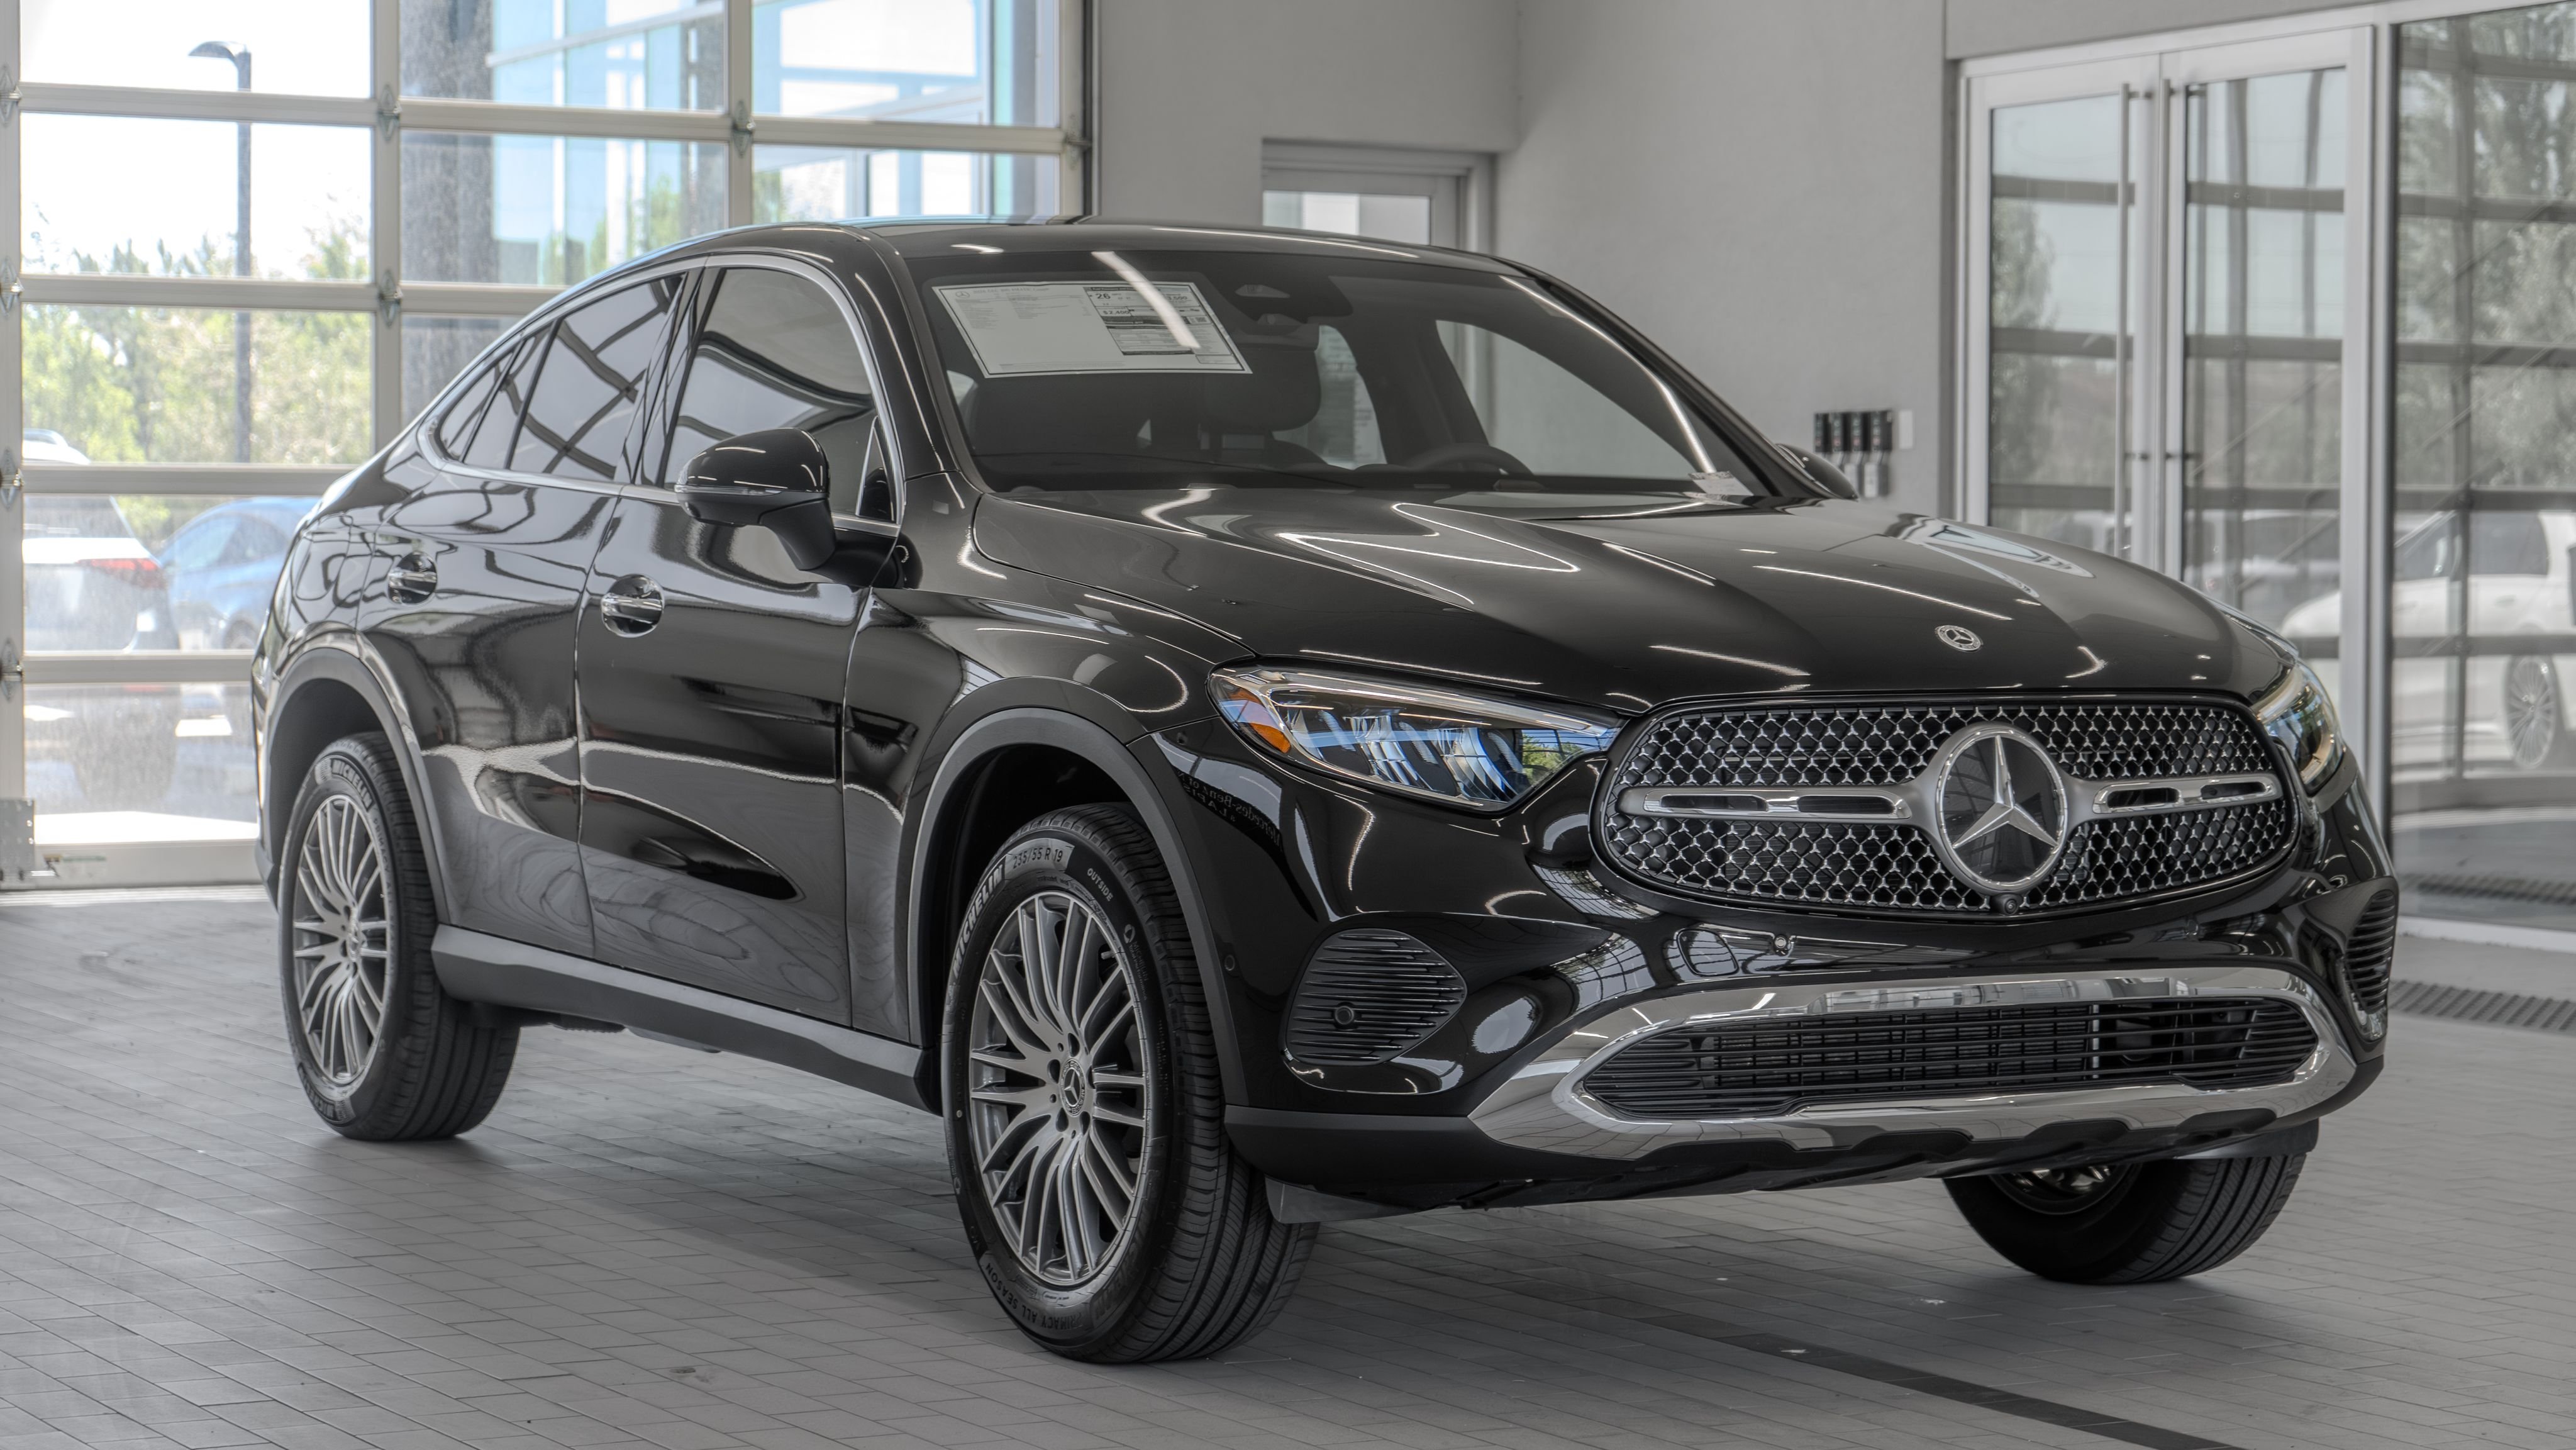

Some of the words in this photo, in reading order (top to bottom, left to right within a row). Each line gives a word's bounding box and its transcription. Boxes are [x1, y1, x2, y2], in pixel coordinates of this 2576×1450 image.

[332, 759, 372, 809] MICHELIN
[1013, 847, 1043, 869] 235/55
[1044, 847, 1052, 861] R
[1053, 848, 1063, 863] 19
[1086, 867, 1114, 901] OUTSIDE
[952, 863, 1003, 979] MICHELIN
[985, 1263, 1018, 1310] SEASON
[1021, 1304, 1038, 1323] ALL
